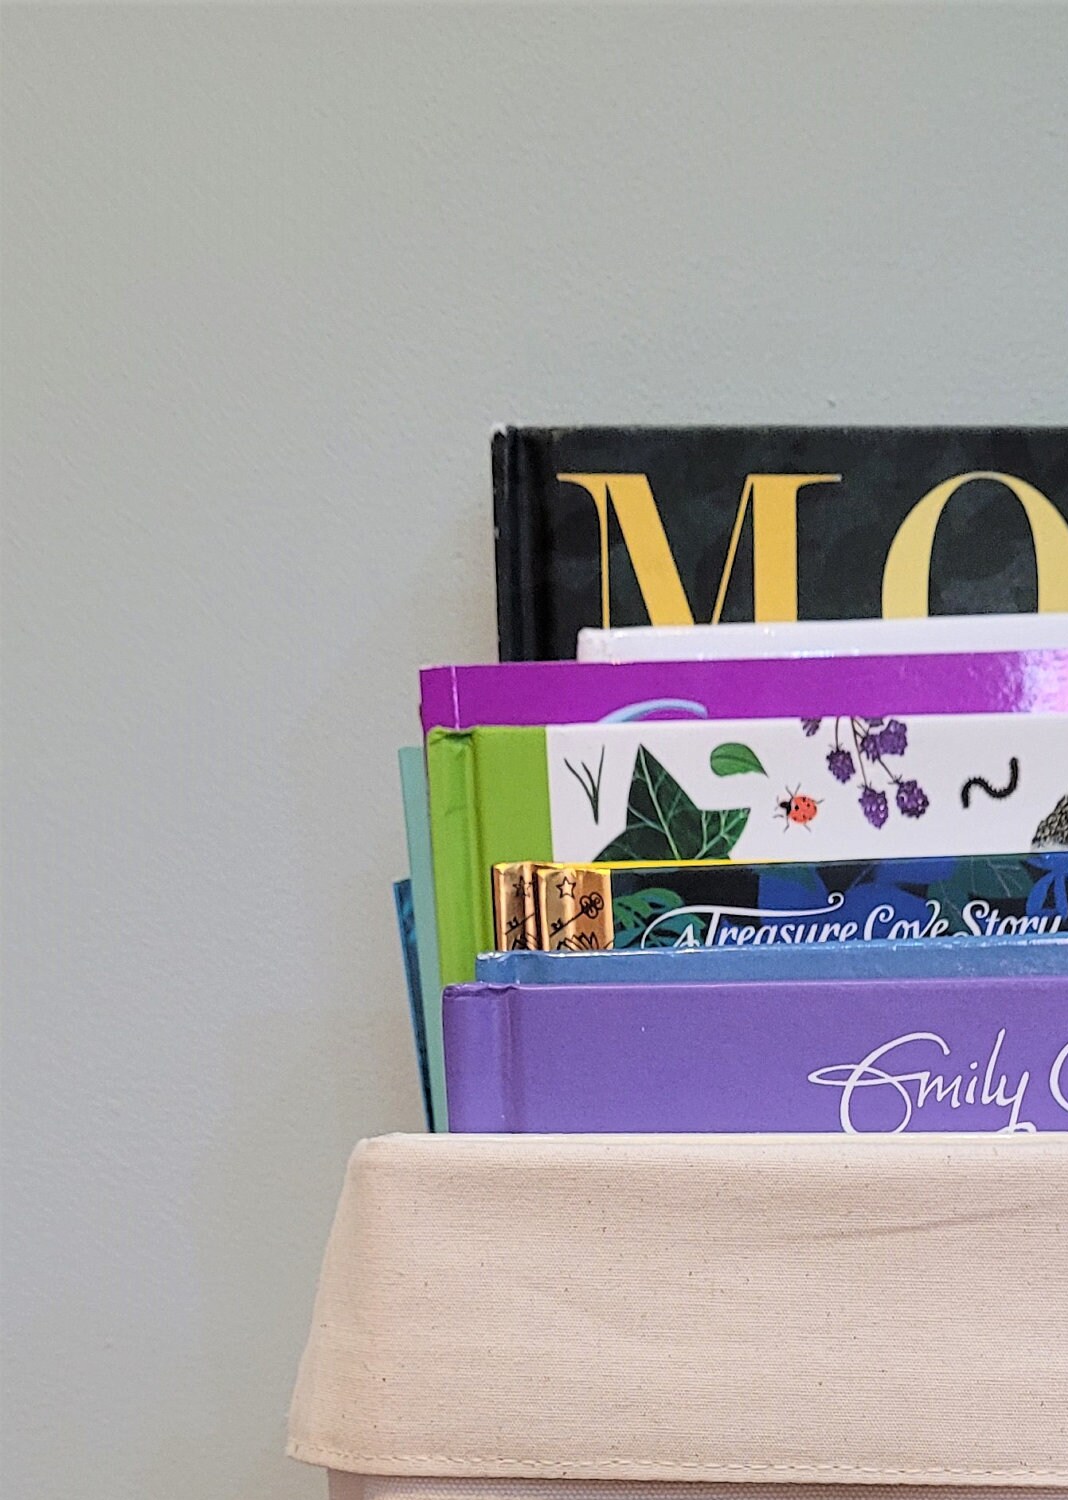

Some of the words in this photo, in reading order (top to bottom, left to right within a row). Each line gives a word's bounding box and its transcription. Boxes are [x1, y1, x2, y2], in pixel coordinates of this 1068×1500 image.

[641, 891, 858, 947] Treasure
[953, 899, 1064, 938] Story
[808, 1028, 1037, 1133] Emily
